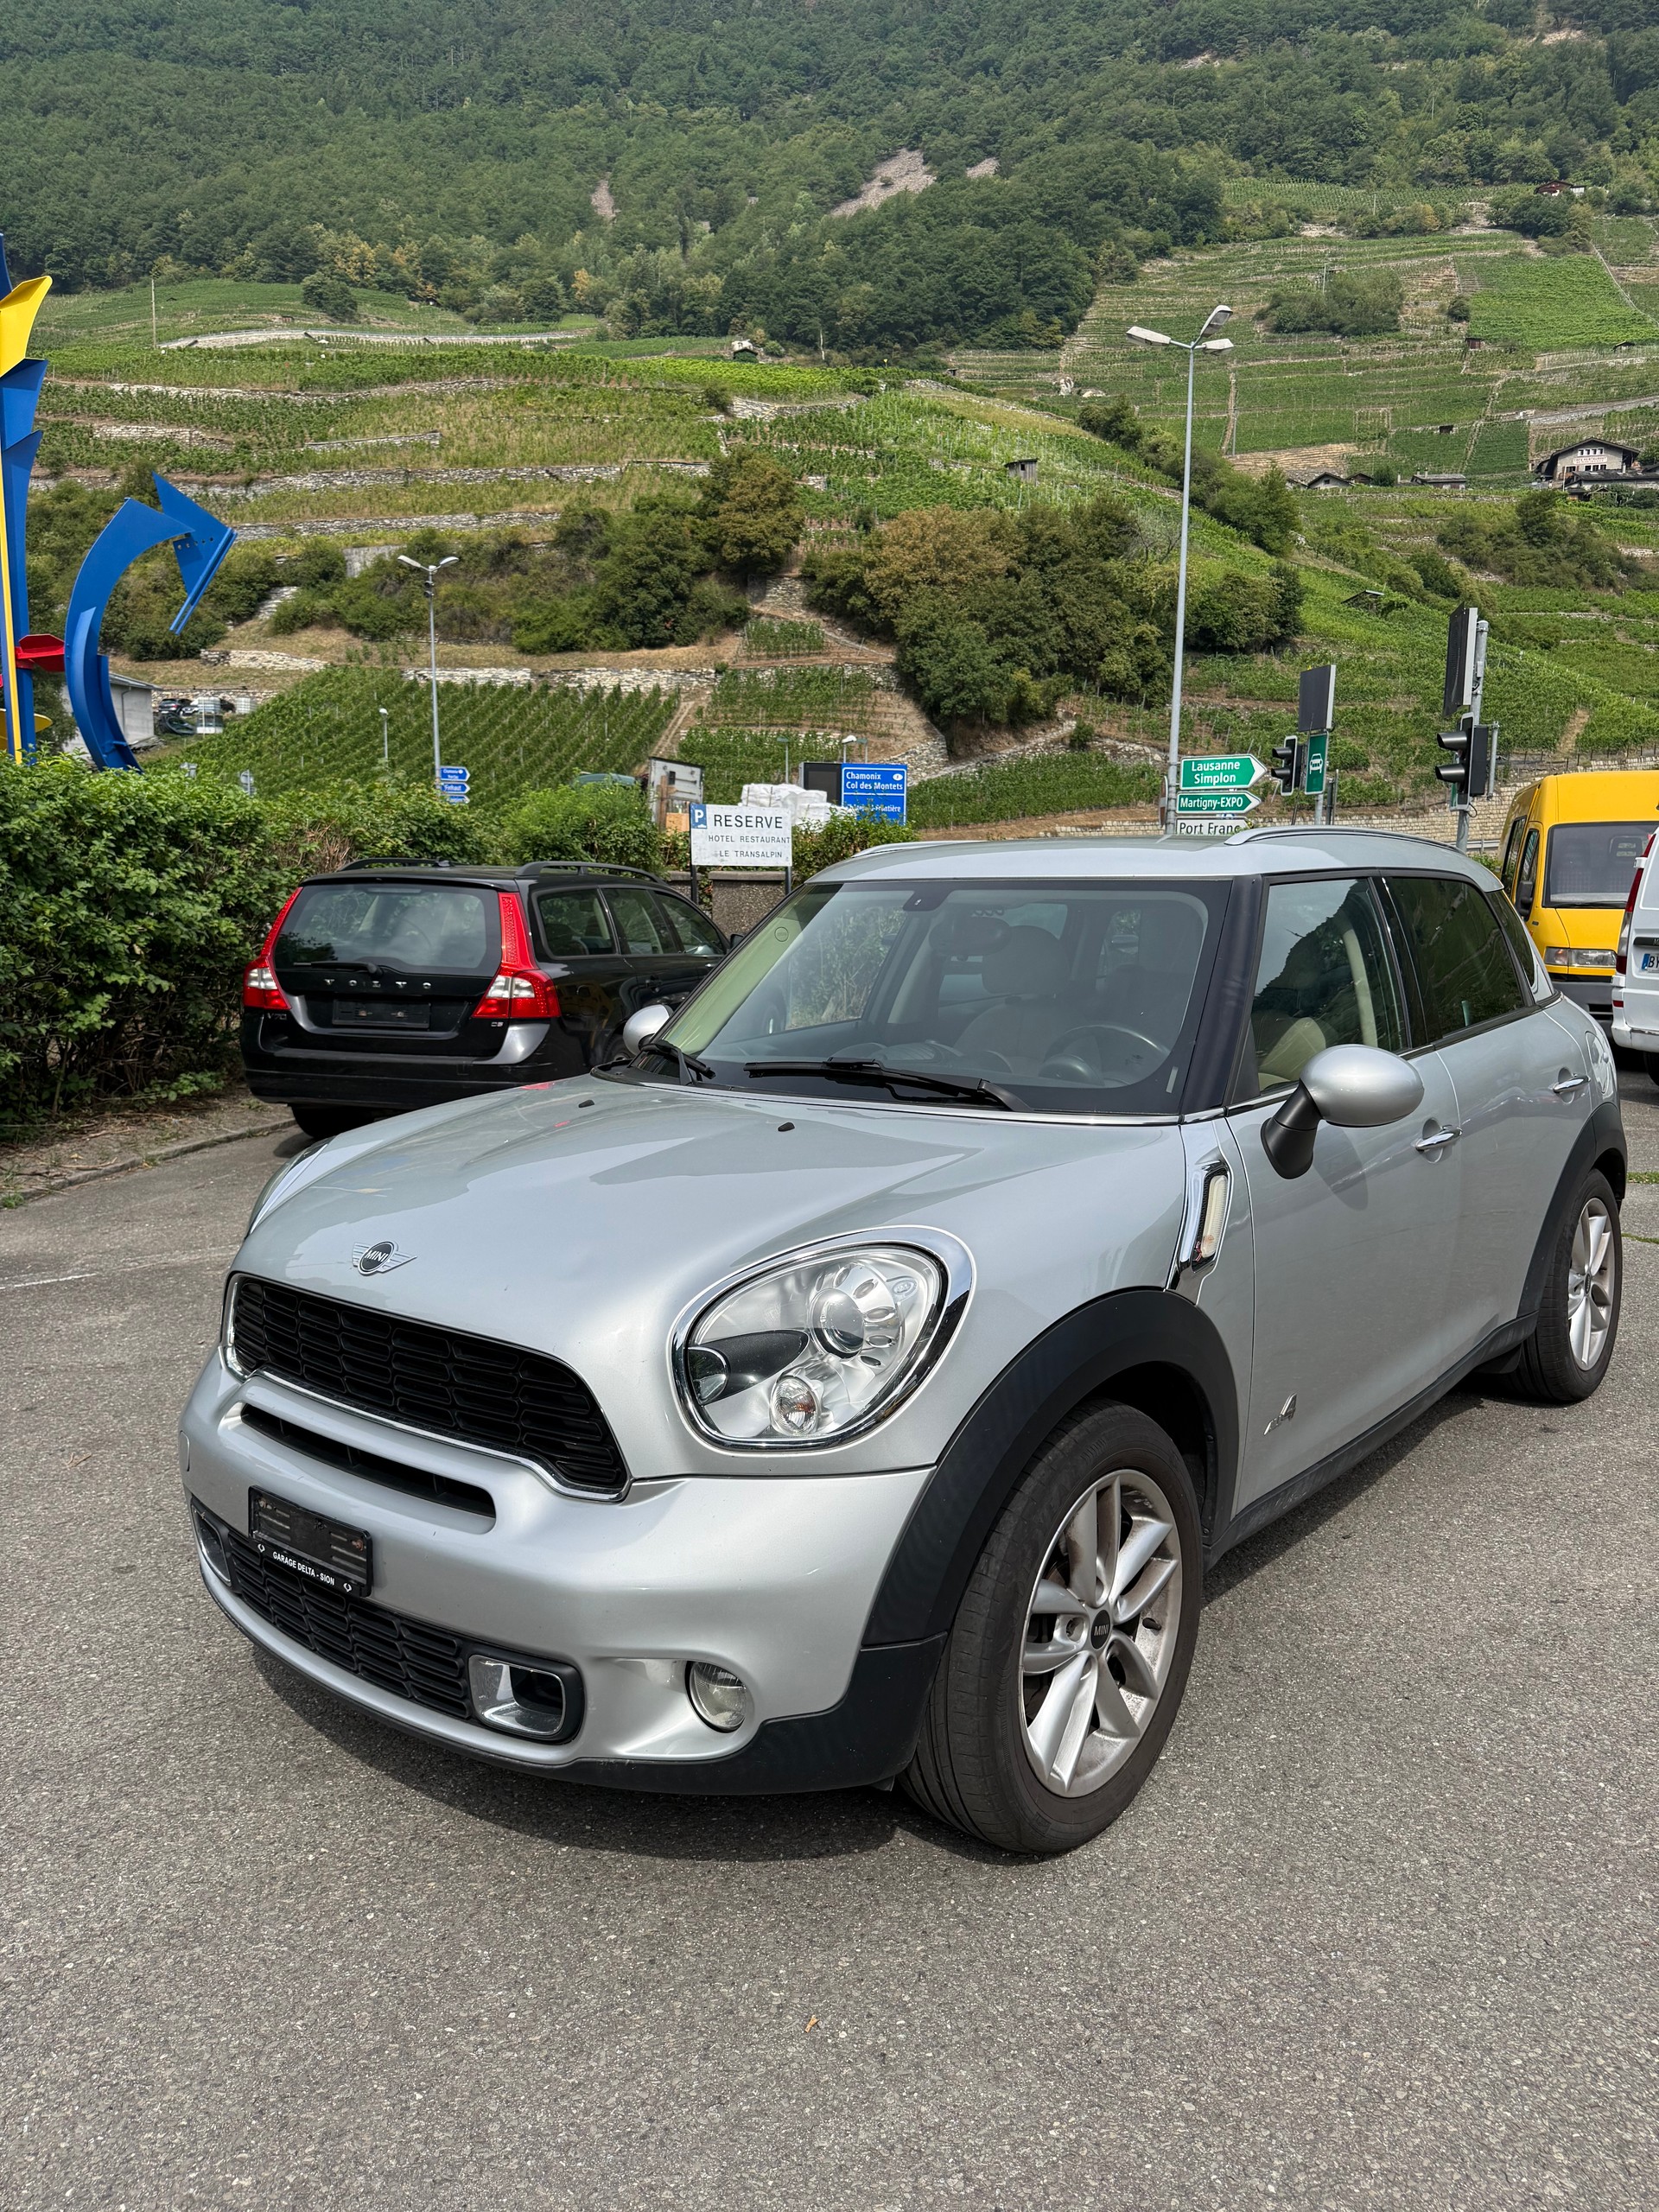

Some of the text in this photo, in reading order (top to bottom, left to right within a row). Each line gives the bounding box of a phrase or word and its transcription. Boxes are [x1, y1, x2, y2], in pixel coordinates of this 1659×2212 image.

[1192, 761, 1241, 772] Lausanne
[846, 772, 881, 780] Chamonix
[1194, 772, 1236, 785] Simplon
[860, 781, 872, 790] des
[1179, 797, 1243, 810] Martigny-EXPO
[694, 810, 704, 823] P
[714, 814, 783, 829] RESERVE
[1179, 823, 1204, 835] Port
[740, 836, 791, 844] RESTAURANT
[324, 978, 432, 989] VOLVO
[364, 1249, 389, 1262] MINI
[272, 1551, 296, 1568] GARAGE
[297, 1562, 315, 1577] DELTA
[320, 1573, 335, 1586] SION
